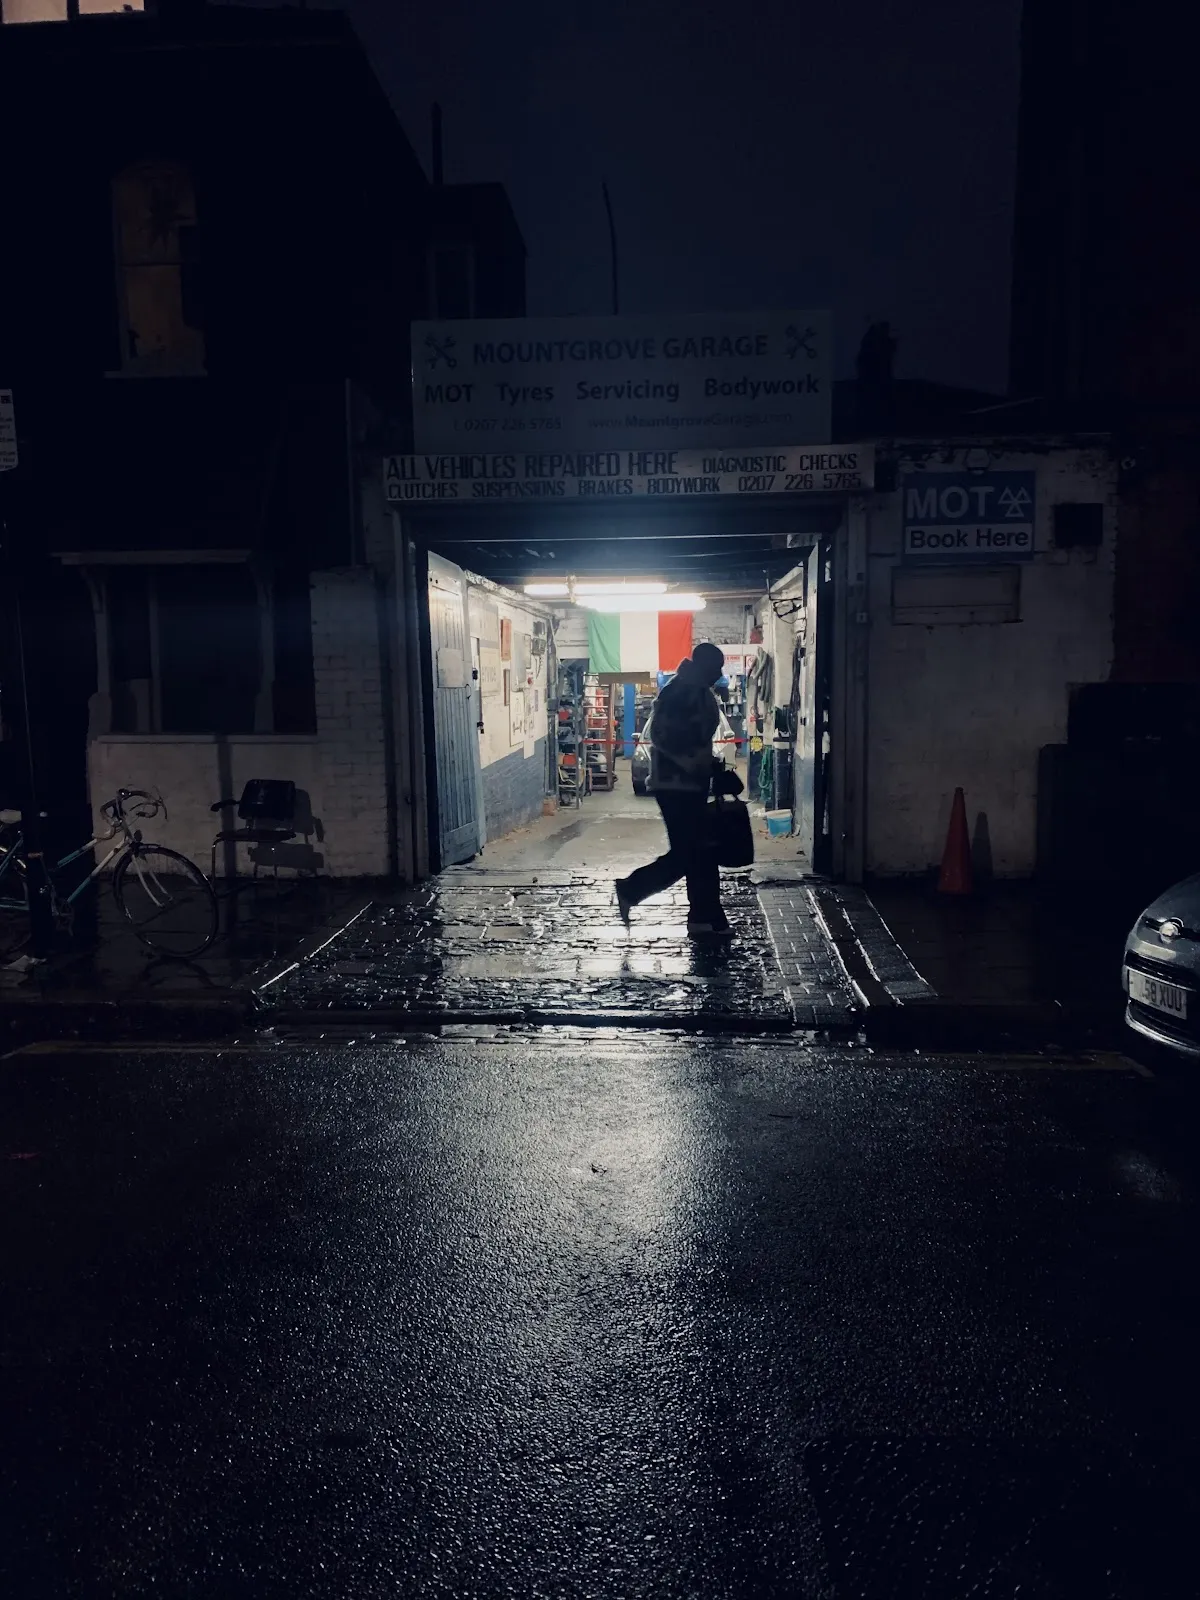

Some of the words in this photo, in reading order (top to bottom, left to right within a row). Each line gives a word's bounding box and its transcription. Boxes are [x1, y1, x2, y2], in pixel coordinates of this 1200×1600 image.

[473, 338, 656, 365] MOUNTGROVE
[663, 334, 768, 360] GARAGE
[424, 383, 474, 404] MOT
[495, 381, 555, 406] Tyres
[576, 378, 680, 404] Servicing
[704, 373, 819, 400] Bodywork
[464, 418, 499, 433] 0207
[387, 456, 420, 481] ALL
[424, 454, 516, 481] VEHICLES
[525, 453, 621, 479] REPAIRED
[628, 451, 680, 476] HERE
[703, 454, 787, 474] DIAGNOSTIC
[800, 453, 858, 472] CHECKS
[387, 482, 459, 500] CLUTCHES
[472, 480, 566, 498] SUSPENSIONS
[578, 478, 633, 496] BRAKES
[647, 477, 720, 495] BODYWORK
[738, 475, 774, 493] 0207
[785, 474, 814, 491] 226
[823, 472, 862, 490] 5765
[906, 486, 995, 520] MOT
[910, 527, 968, 549] Book
[976, 527, 1030, 548] Here
